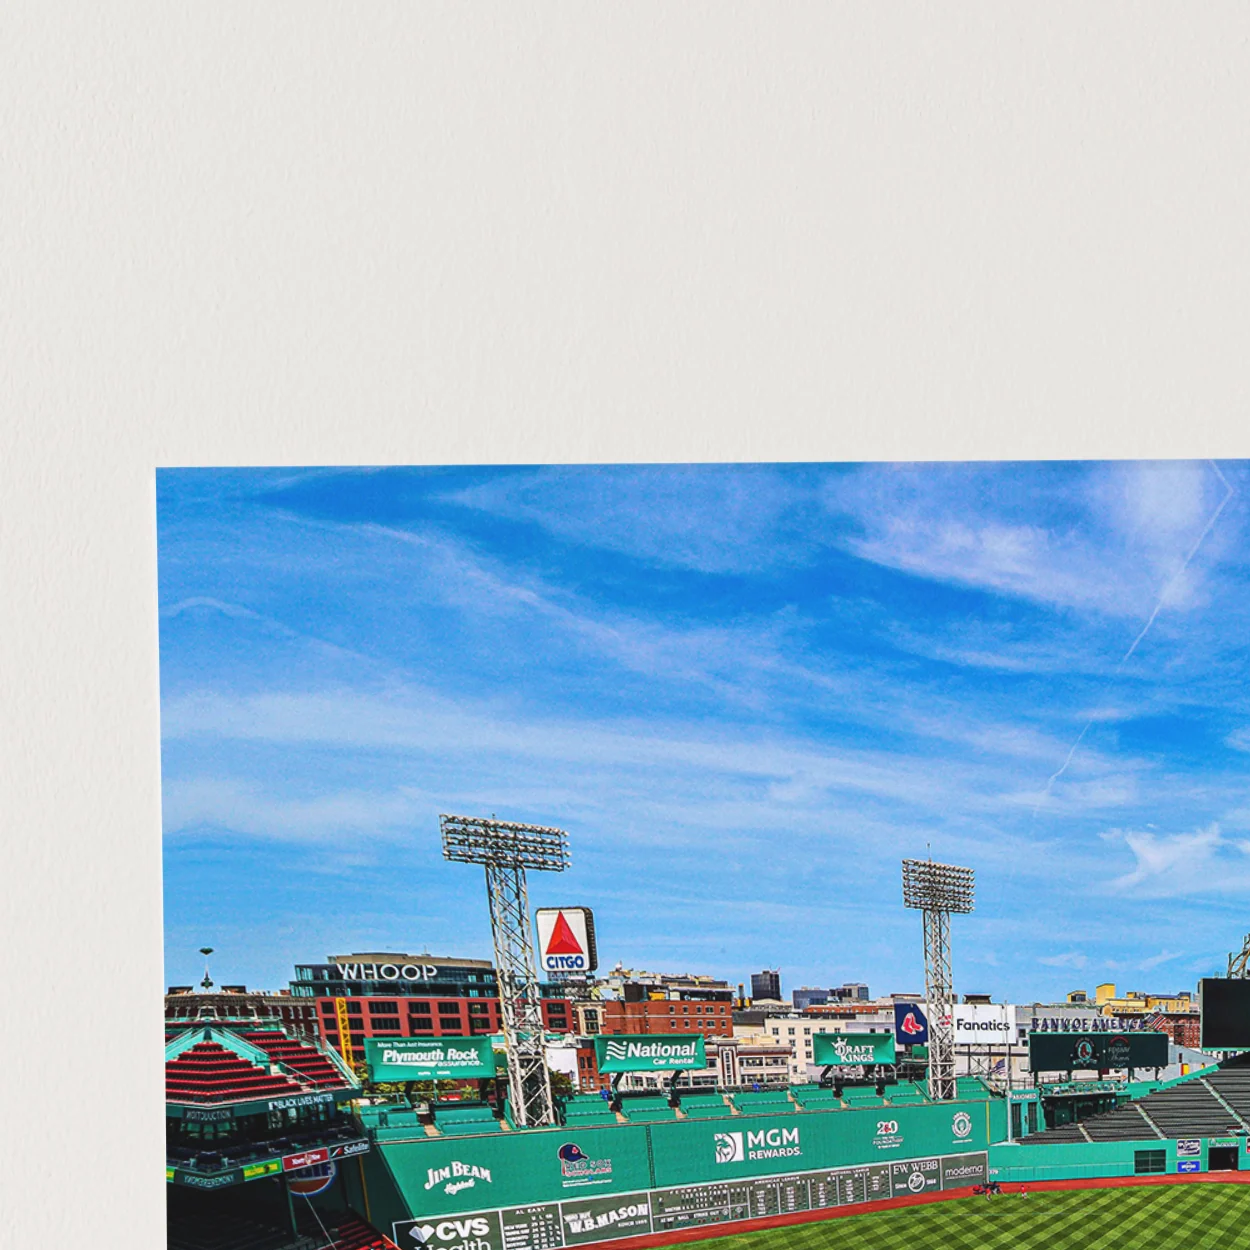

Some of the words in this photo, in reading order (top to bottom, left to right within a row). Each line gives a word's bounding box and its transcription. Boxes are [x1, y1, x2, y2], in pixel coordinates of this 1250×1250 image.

[547, 956, 584, 969] CITGO
[337, 963, 438, 981] WHOOP
[956, 1018, 1010, 1032] Fanatics
[1032, 1017, 1071, 1031] BANK
[1072, 1017, 1088, 1031] OF
[1090, 1017, 1145, 1031] AMERICA
[383, 1048, 445, 1063] Plymouth
[446, 1047, 479, 1061] Rock
[652, 1057, 667, 1065] Car
[669, 1057, 695, 1065] Rental
[841, 1054, 875, 1063] KINGS
[277, 1099, 297, 1109] BLACK
[297, 1097, 313, 1106] LIVES
[313, 1093, 334, 1104] MATTER
[747, 1127, 800, 1148] MGM
[343, 1143, 369, 1155] Safelite
[910, 1160, 939, 1172] WEBB
[945, 1164, 984, 1176] moderna
[424, 1166, 451, 1191] JIM
[450, 1160, 493, 1184] BEAM
[527, 1206, 546, 1214] EAST
[436, 1216, 490, 1242] CVS
